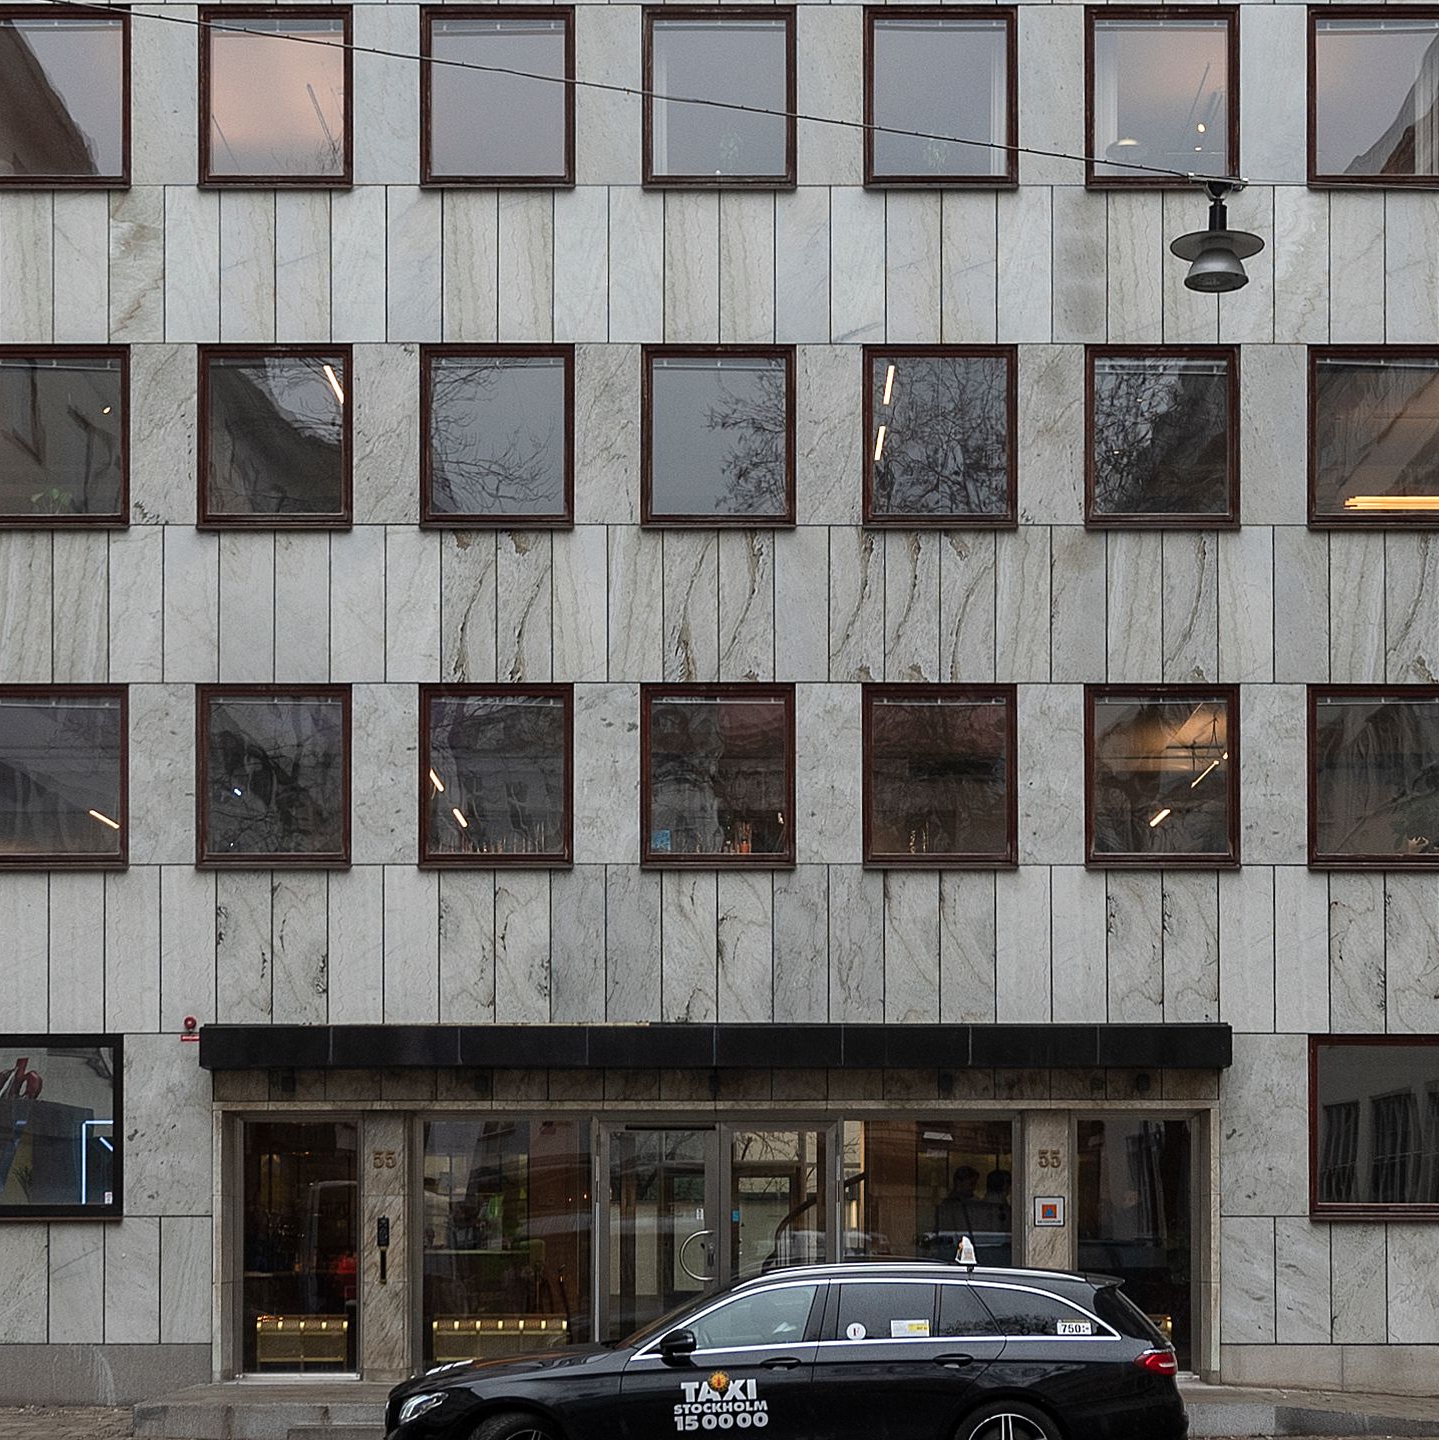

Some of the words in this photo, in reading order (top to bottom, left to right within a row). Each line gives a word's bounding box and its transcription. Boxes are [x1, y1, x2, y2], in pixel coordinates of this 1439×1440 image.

[373, 1150, 396, 1169] 55
[1038, 1149, 1061, 1168] 55
[680, 1379, 757, 1403] TAXI
[673, 1400, 768, 1415] STOCKHOLM
